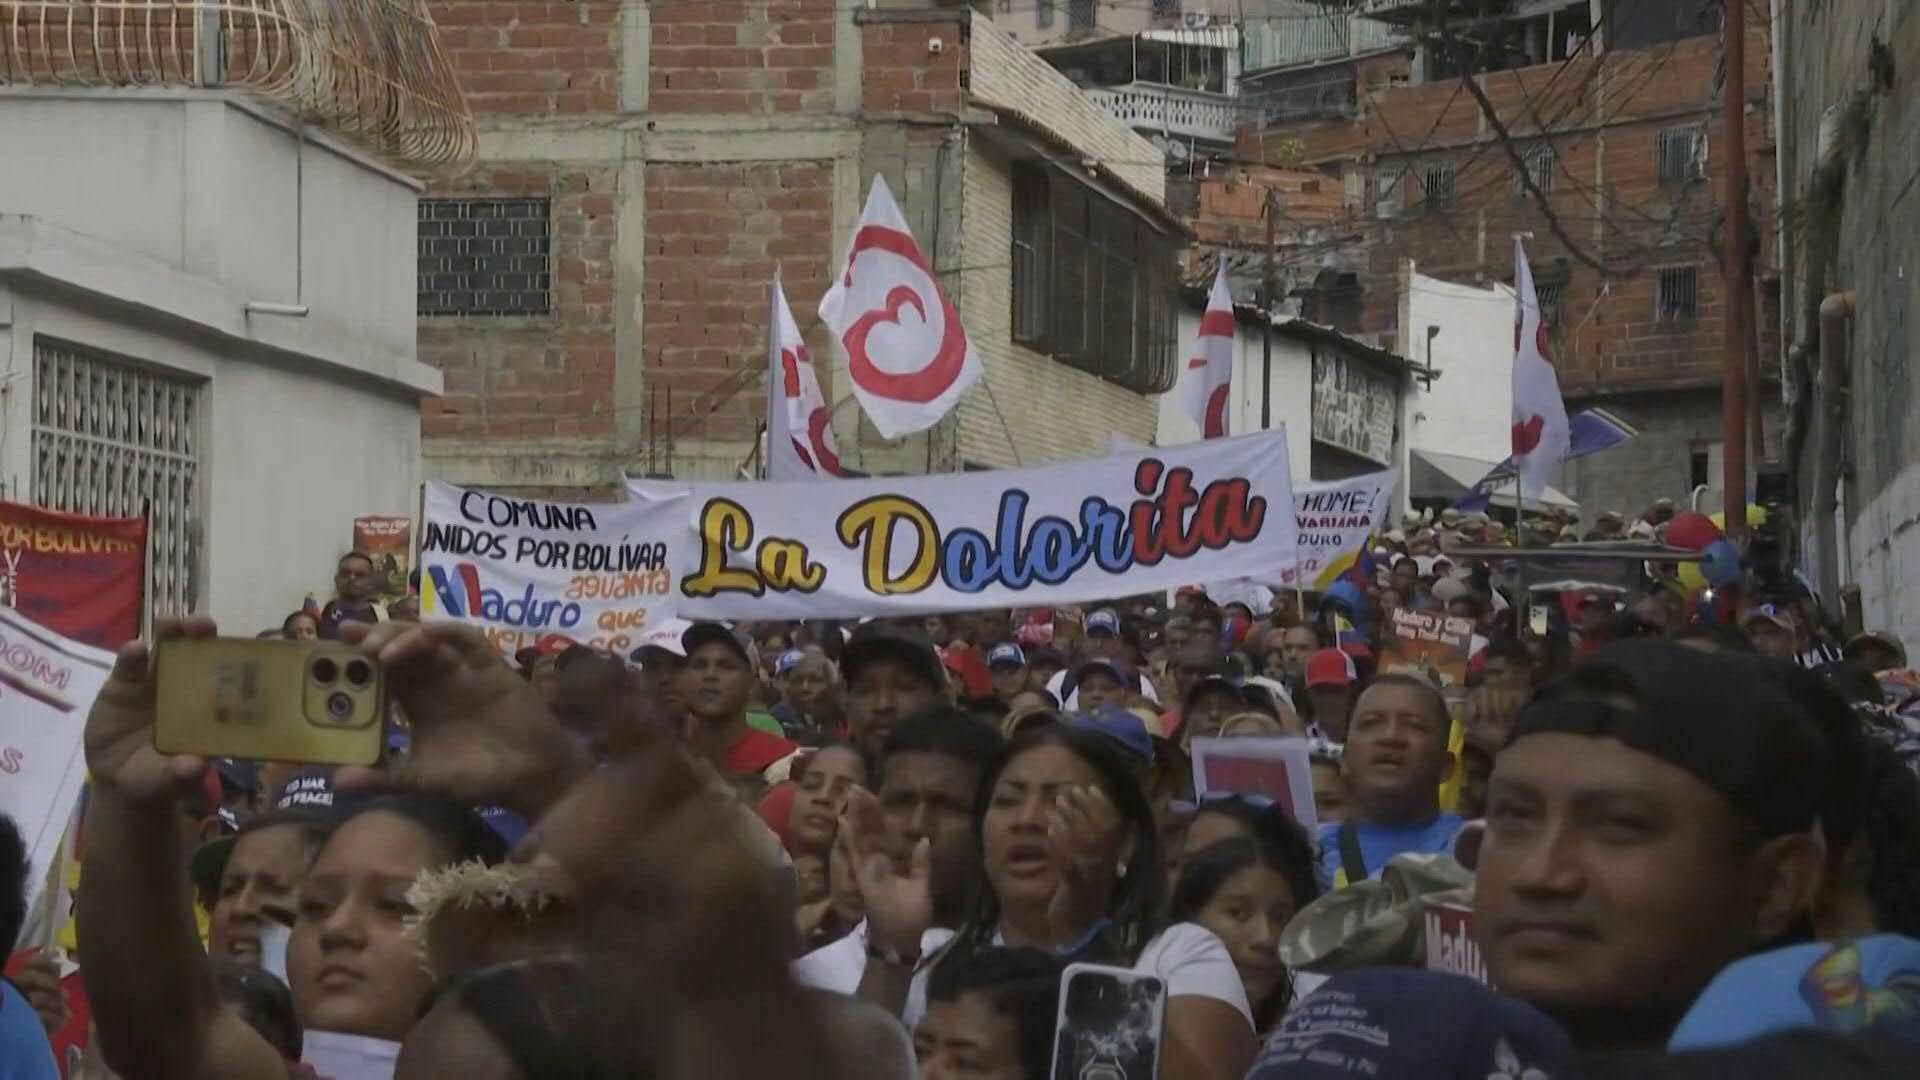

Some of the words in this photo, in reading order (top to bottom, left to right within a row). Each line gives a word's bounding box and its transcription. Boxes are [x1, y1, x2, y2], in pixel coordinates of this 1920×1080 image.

[460, 490, 597, 532] COMUNA
[1302, 487, 1381, 513] HOME!
[680, 496, 829, 600] La
[835, 457, 1266, 597] Dolorita
[1297, 533, 1343, 547] DURO
[515, 536, 569, 570] POR
[571, 533, 668, 573] BOLÍVAR
[419, 562, 582, 630] Maduro
[597, 607, 647, 634] que
